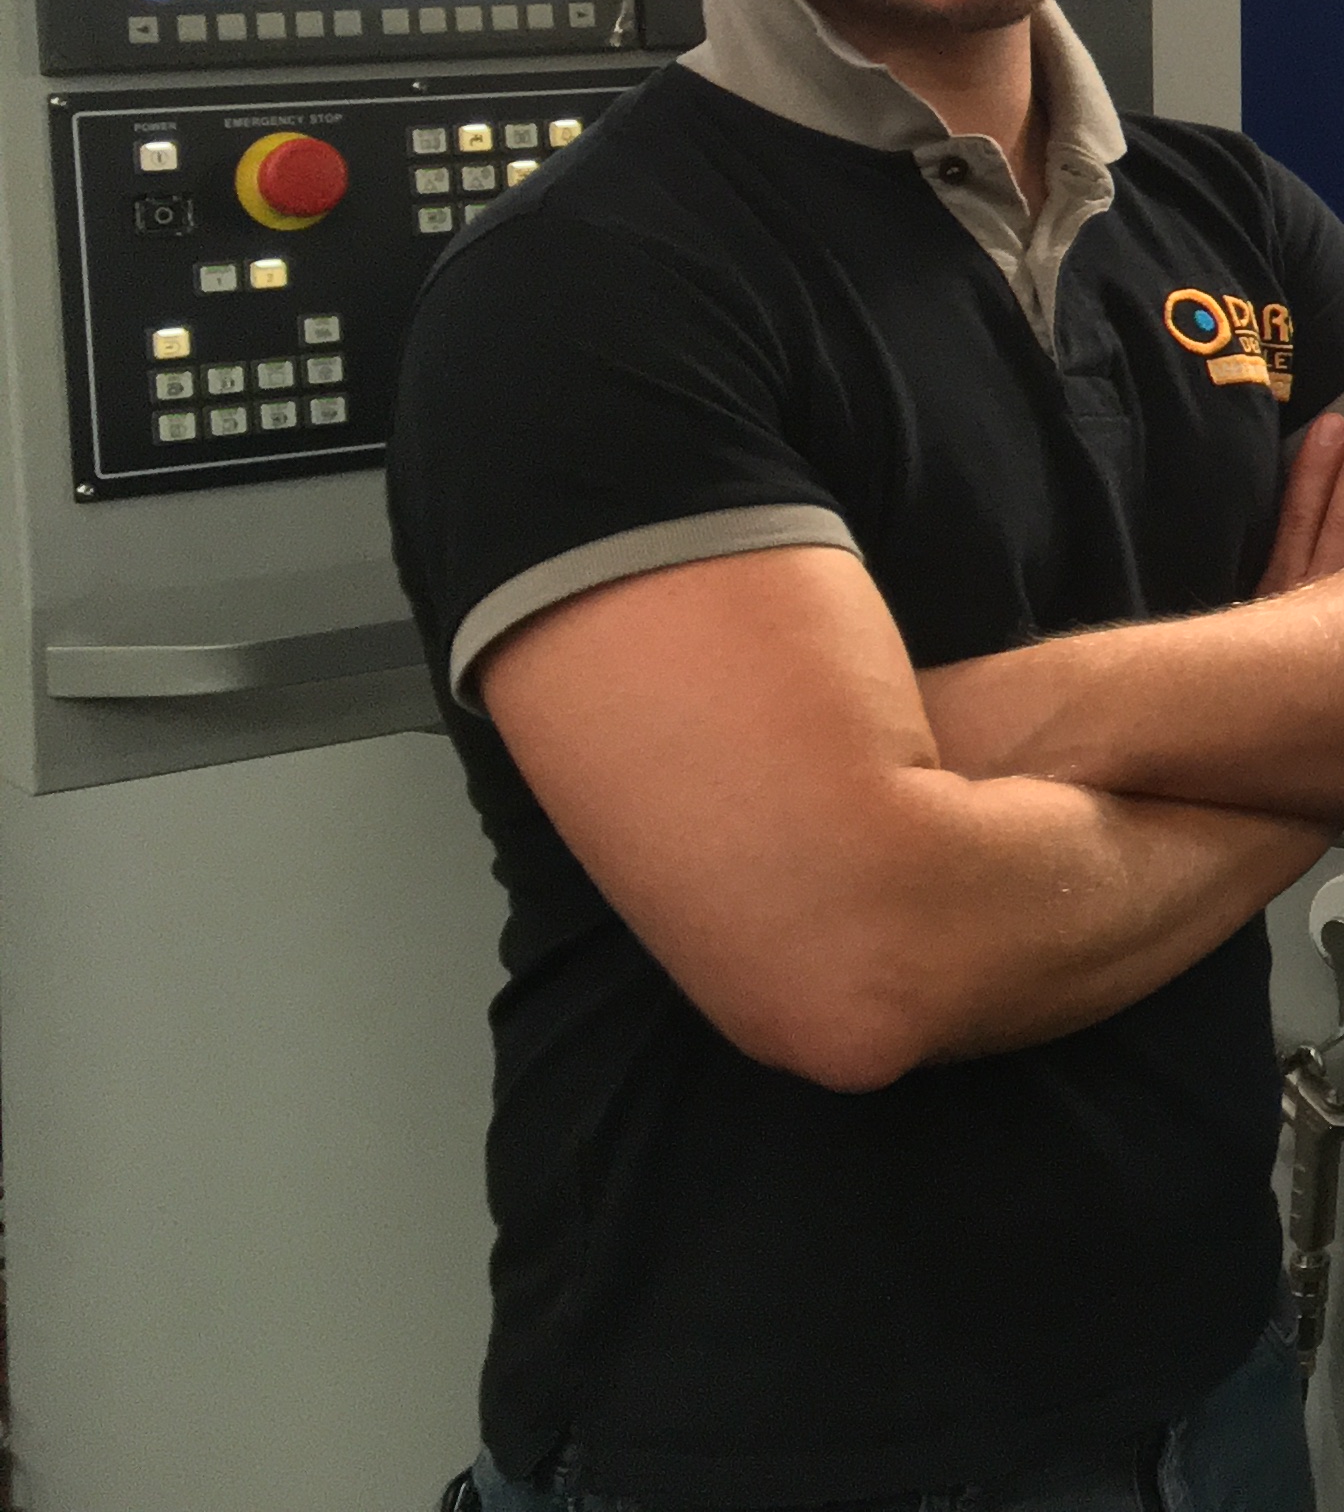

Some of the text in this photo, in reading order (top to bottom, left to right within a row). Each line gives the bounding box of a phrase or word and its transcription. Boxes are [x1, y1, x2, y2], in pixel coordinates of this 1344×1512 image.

[224, 113, 343, 128] EMERGENCY STOP
[133, 122, 177, 132] POWER
